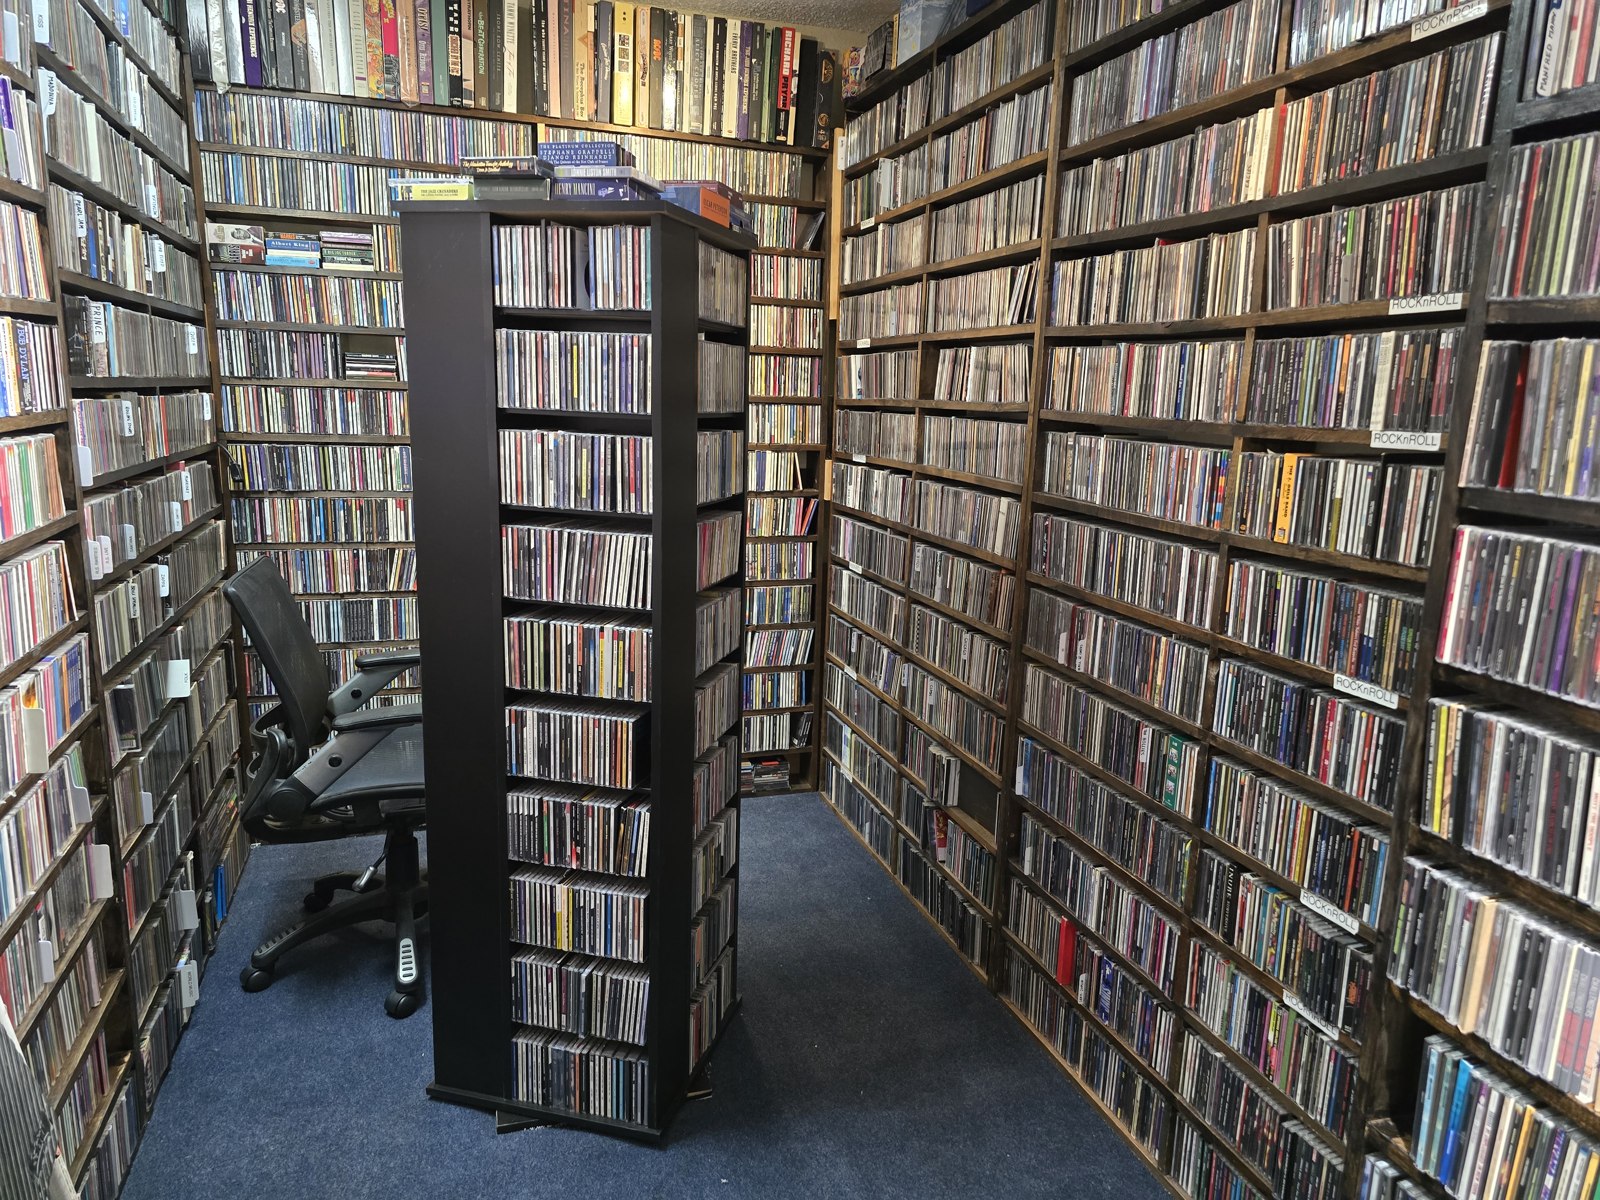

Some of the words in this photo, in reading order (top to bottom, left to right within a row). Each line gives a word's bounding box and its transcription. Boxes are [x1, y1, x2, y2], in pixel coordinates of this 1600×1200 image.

[1414, 1, 1483, 35] ROCKnROLL
[652, 39, 662, 62] AC/DC
[731, 33, 739, 48] EVERLY
[783, 30, 793, 76] RICHARD
[1540, 44, 1553, 91] MANFRED
[47, 74, 55, 106] MADONNA
[554, 183, 572, 196] HENRY
[1392, 295, 1459, 310] ROCKnROLL
[18, 328, 26, 345] BOB
[95, 305, 103, 337] PRINCE
[19, 347, 29, 380] DYLAN
[1373, 432, 1438, 447] ROCKnROLL
[1336, 676, 1396, 706] ROCKnROLL
[1587, 826, 1595, 851] HOOPLE
[1302, 892, 1357, 931] ROCKnROLL
[1584, 977, 1599, 1018] CHALLENGERS
[1285, 993, 1337, 1037] ROCKnROLL
